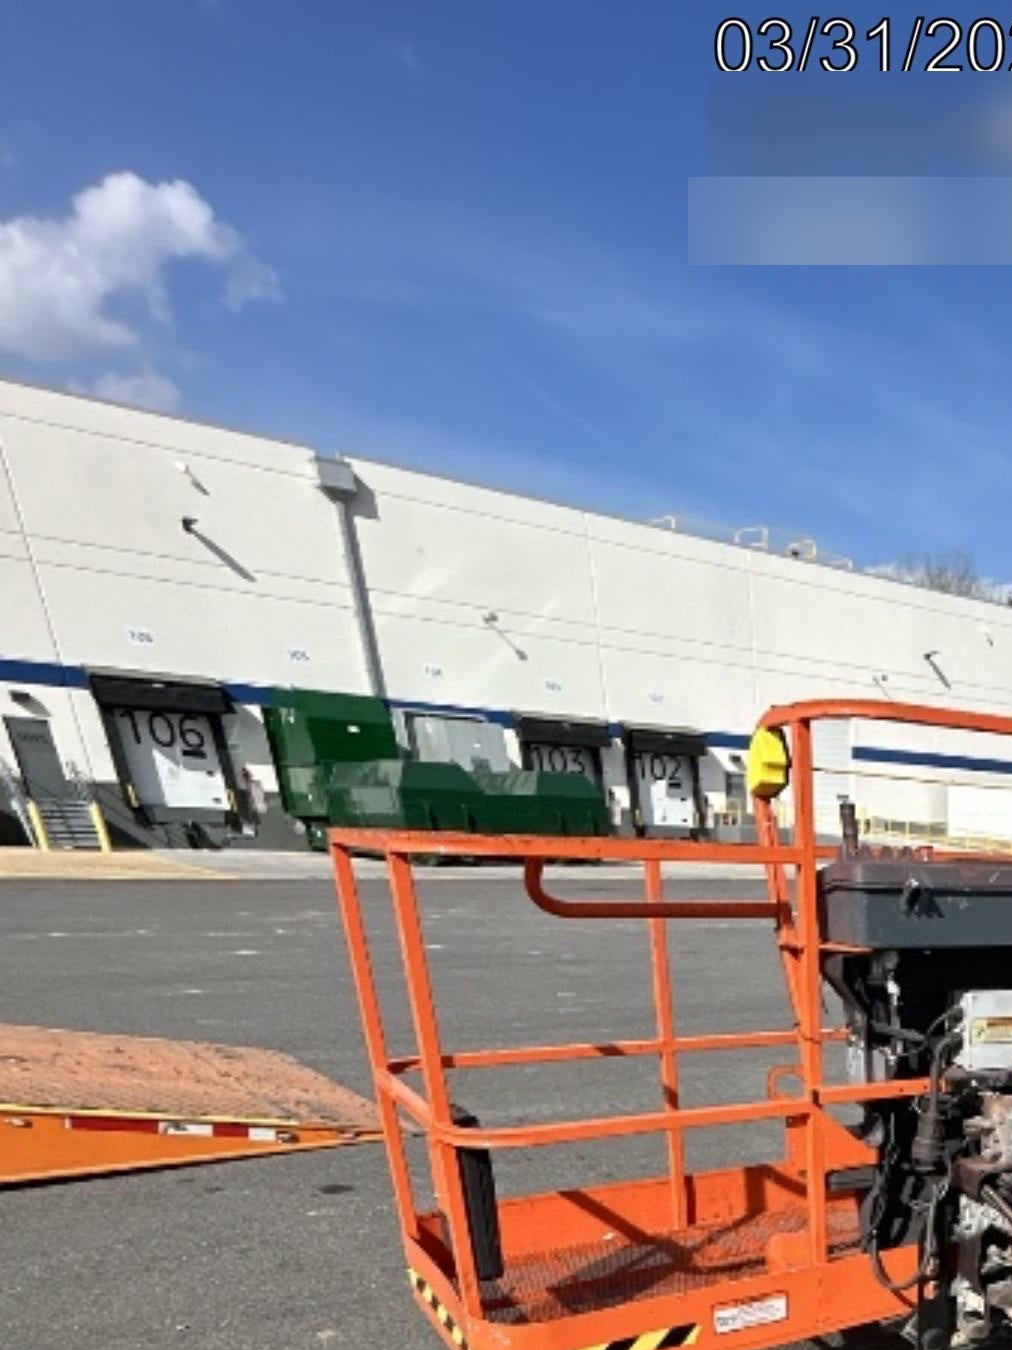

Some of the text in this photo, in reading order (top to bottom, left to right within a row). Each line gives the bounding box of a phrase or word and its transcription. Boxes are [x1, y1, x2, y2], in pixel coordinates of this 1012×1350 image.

[119, 710, 204, 748] 106
[529, 747, 585, 773] 103
[633, 753, 682, 781] 102
